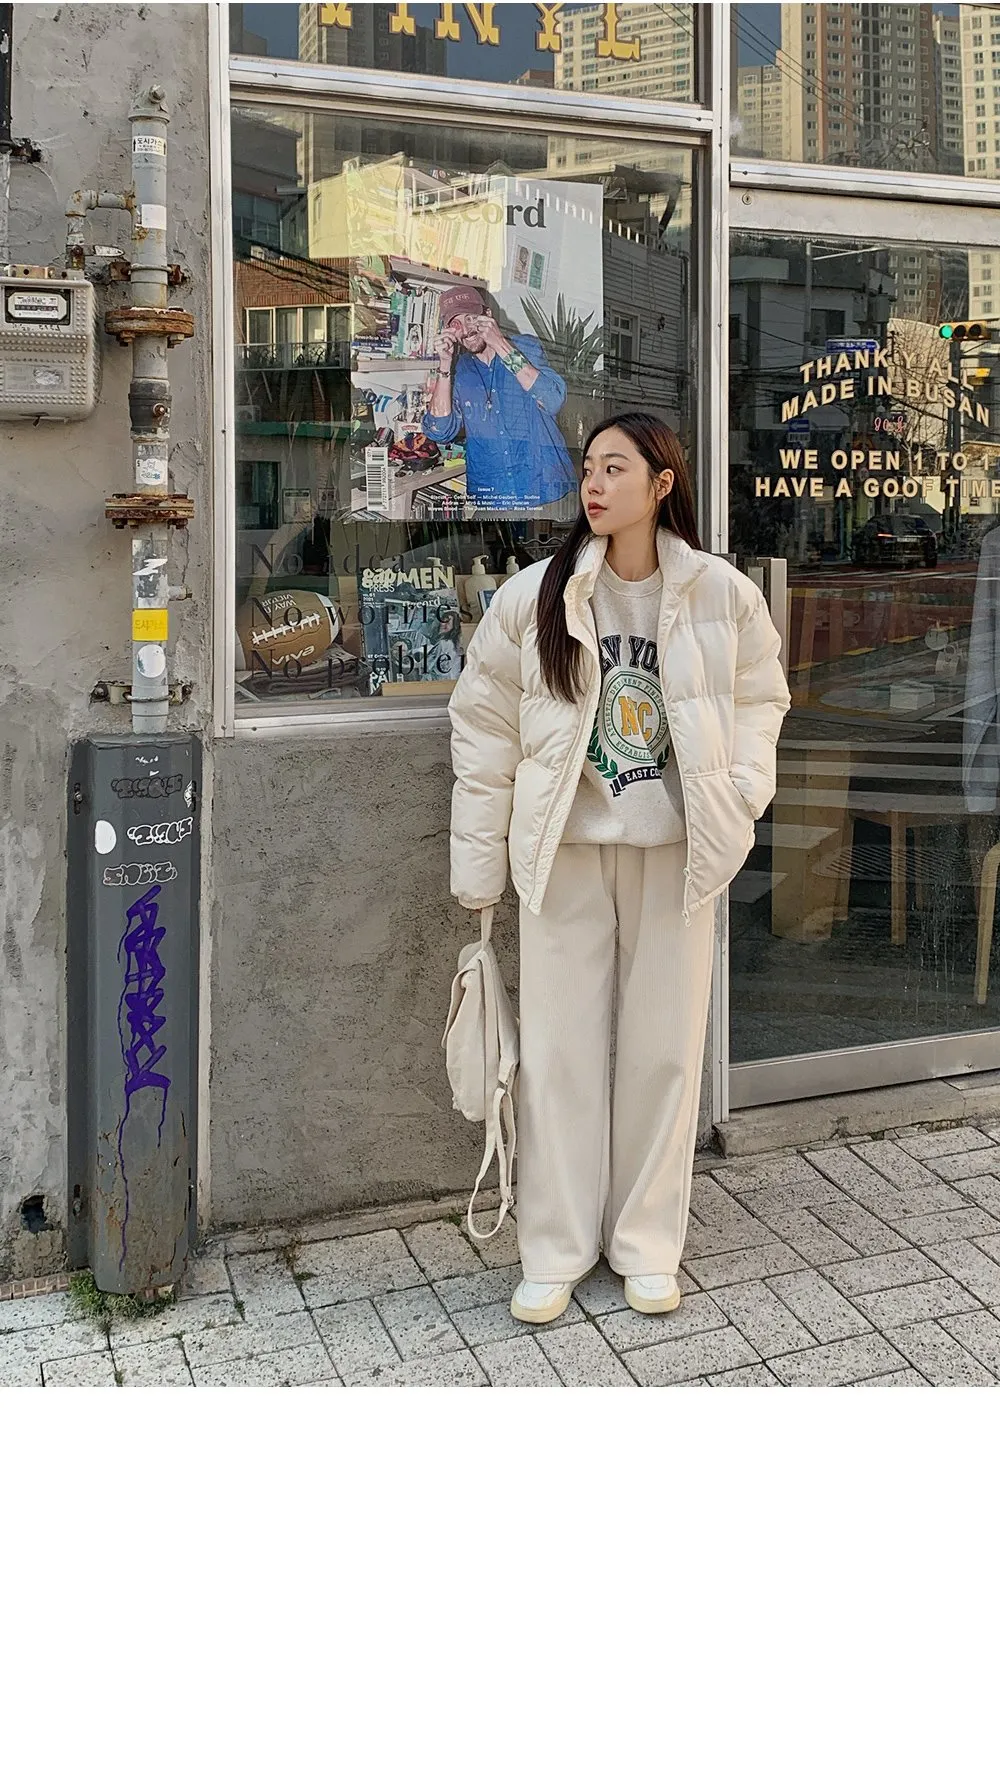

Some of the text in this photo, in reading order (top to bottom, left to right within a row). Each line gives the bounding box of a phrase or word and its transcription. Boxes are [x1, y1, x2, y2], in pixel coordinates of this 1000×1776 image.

[416, 198, 546, 228] ecord
[800, 349, 889, 384] THANK
[781, 376, 989, 427] MADE IN BUSAN
[779, 449, 818, 470] WE
[830, 450, 900, 470] OPEN
[914, 451, 923, 470] 1
[936, 451, 967, 471] TO
[755, 477, 824, 497] HAVE
[835, 478, 858, 497] A
[946, 478, 1000, 498] TIME
[250, 543, 405, 576] No idea
[397, 566, 455, 590] MEN
[250, 596, 474, 628] No worries
[250, 648, 303, 680] No
[272, 645, 315, 666] viva
[618, 695, 653, 741] NC
[624, 769, 648, 782] EAST
